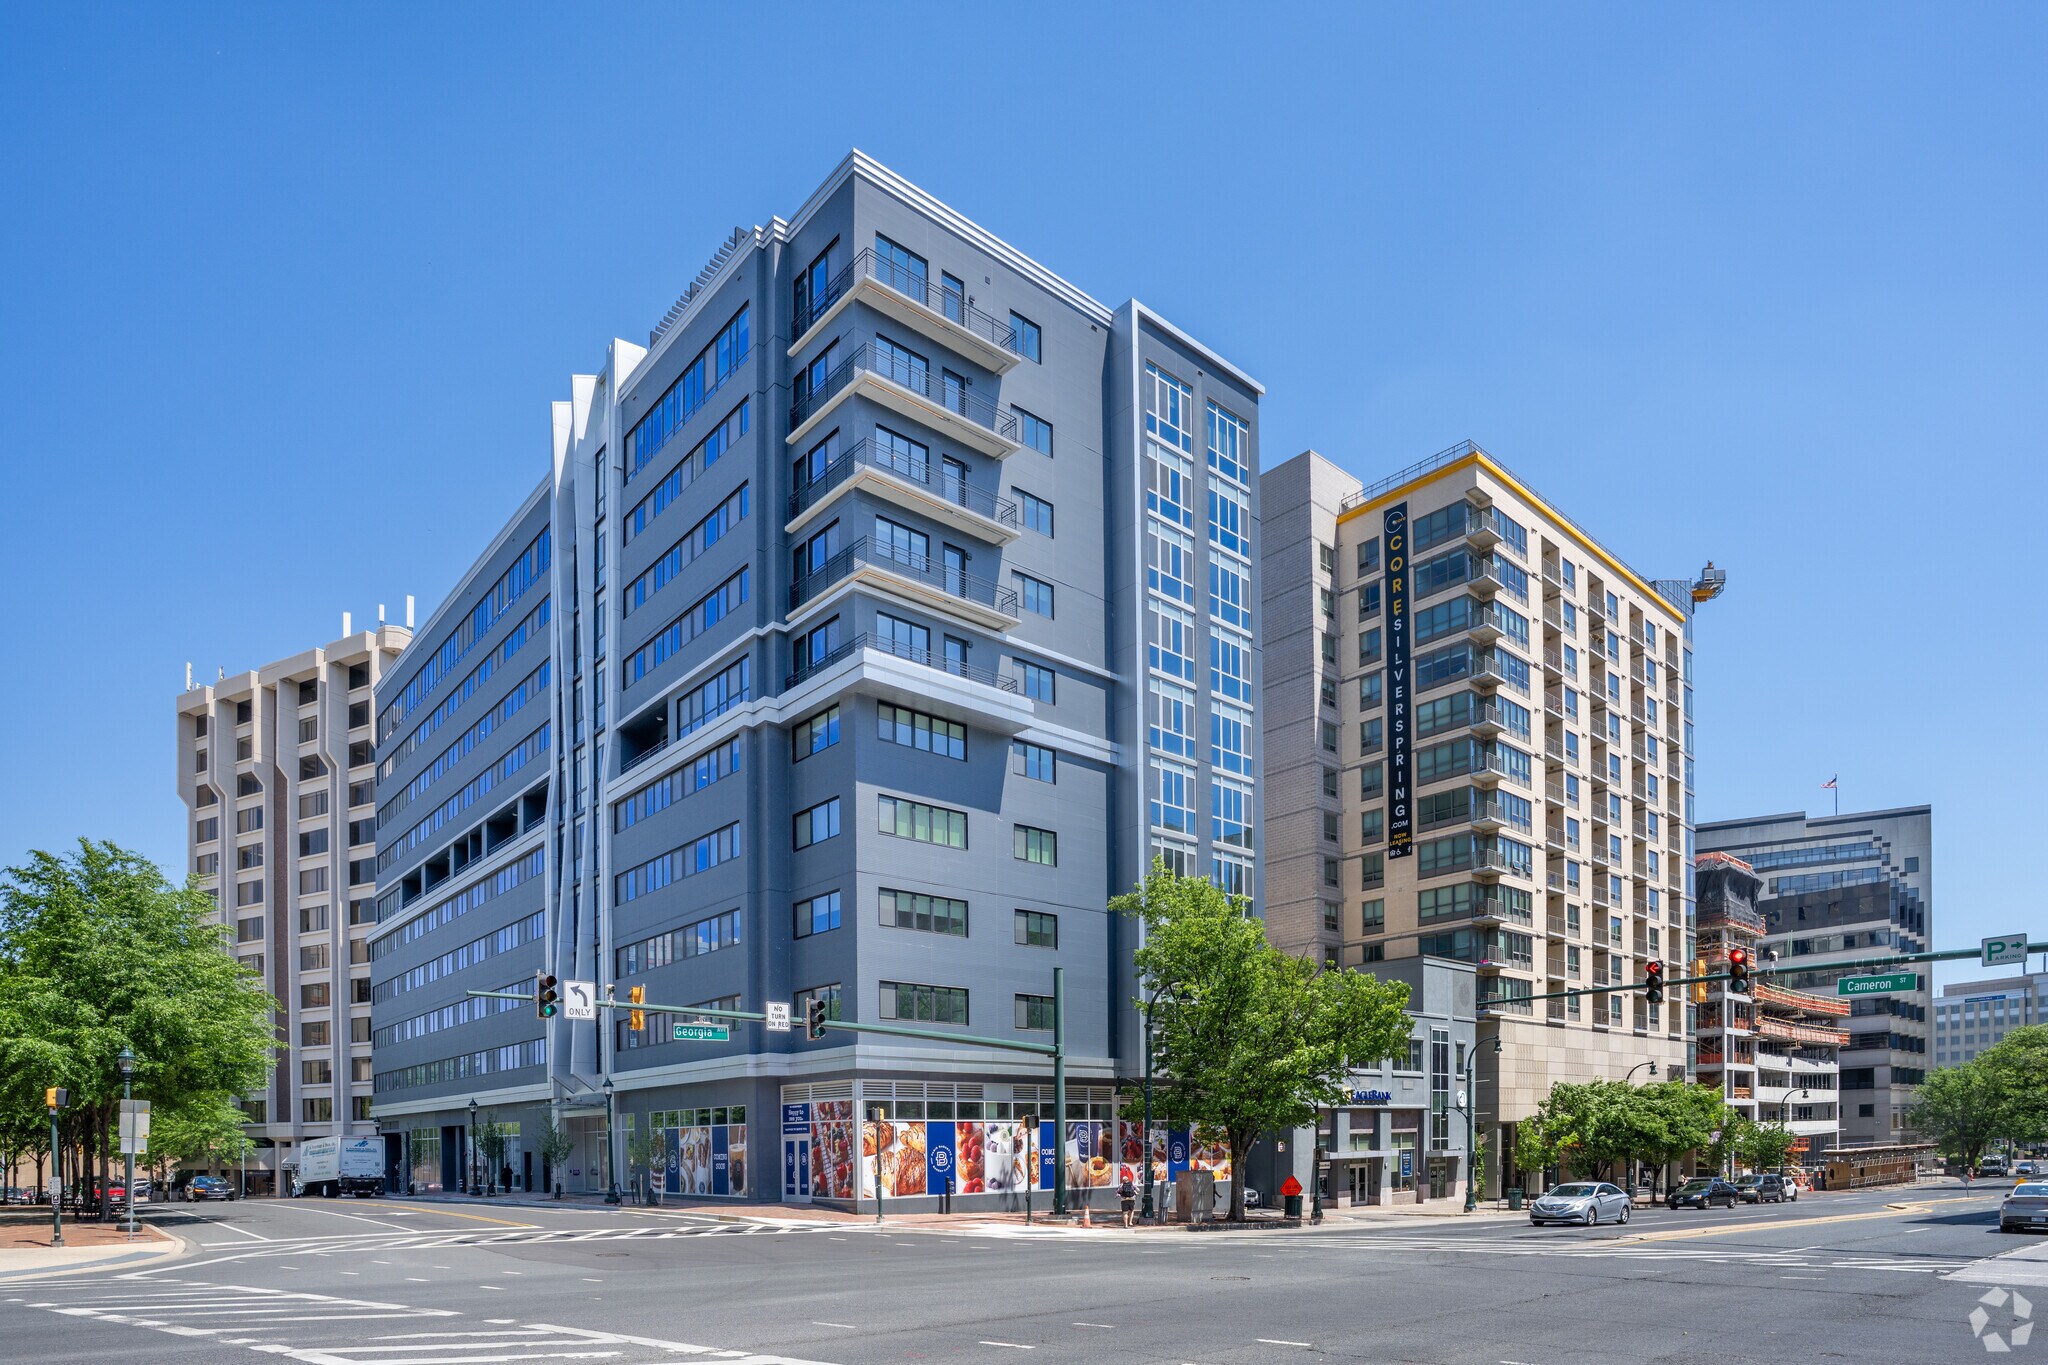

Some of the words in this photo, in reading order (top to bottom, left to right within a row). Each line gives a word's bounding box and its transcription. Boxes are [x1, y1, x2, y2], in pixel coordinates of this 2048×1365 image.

[1390, 837, 1412, 846] LEASING
[1847, 979, 1892, 992] Cameron
[569, 1008, 590, 1016] ONLY
[676, 1026, 712, 1038] Georgia
